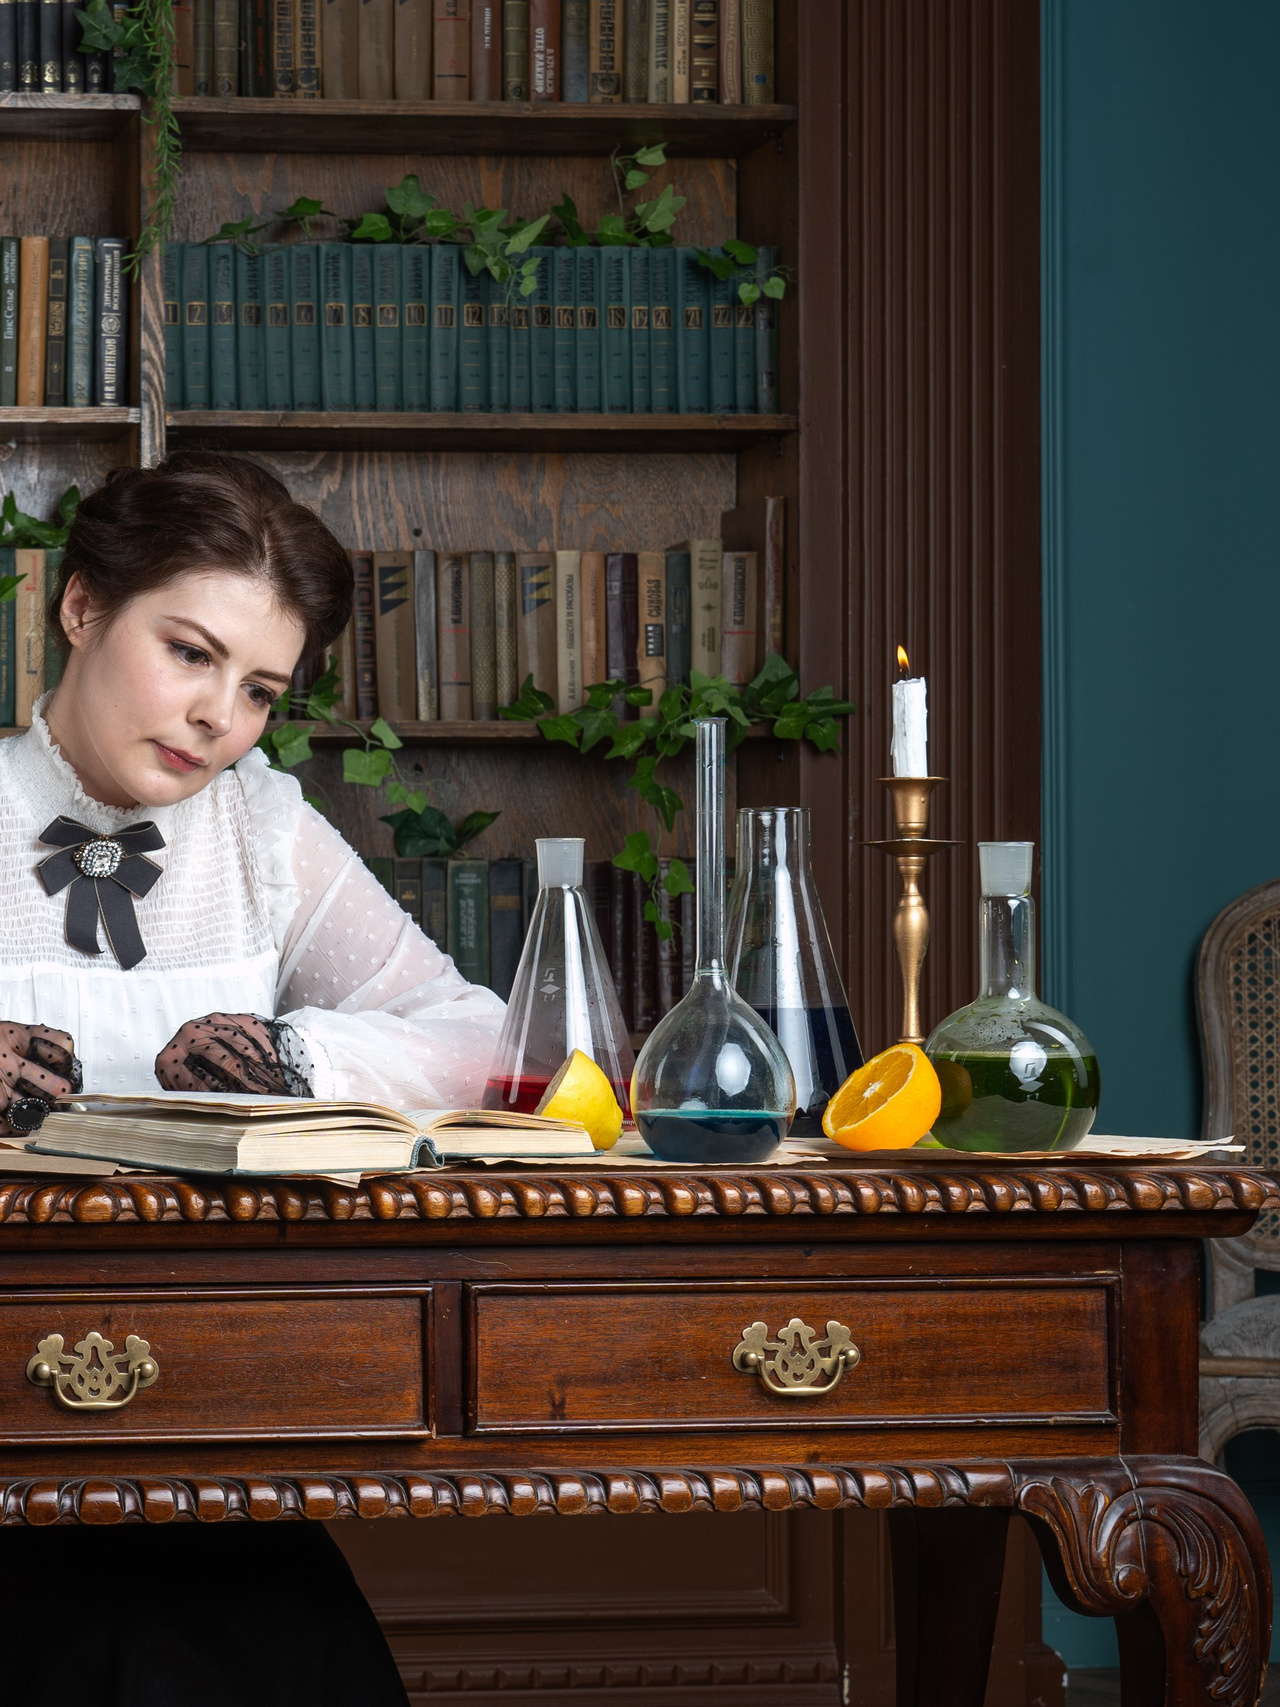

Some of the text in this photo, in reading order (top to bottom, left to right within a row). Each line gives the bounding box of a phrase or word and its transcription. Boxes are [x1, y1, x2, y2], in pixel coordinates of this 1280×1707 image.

[3, 289, 15, 339] Ганс Селье
[647, 579, 661, 618] СЫНОВЬЯ
